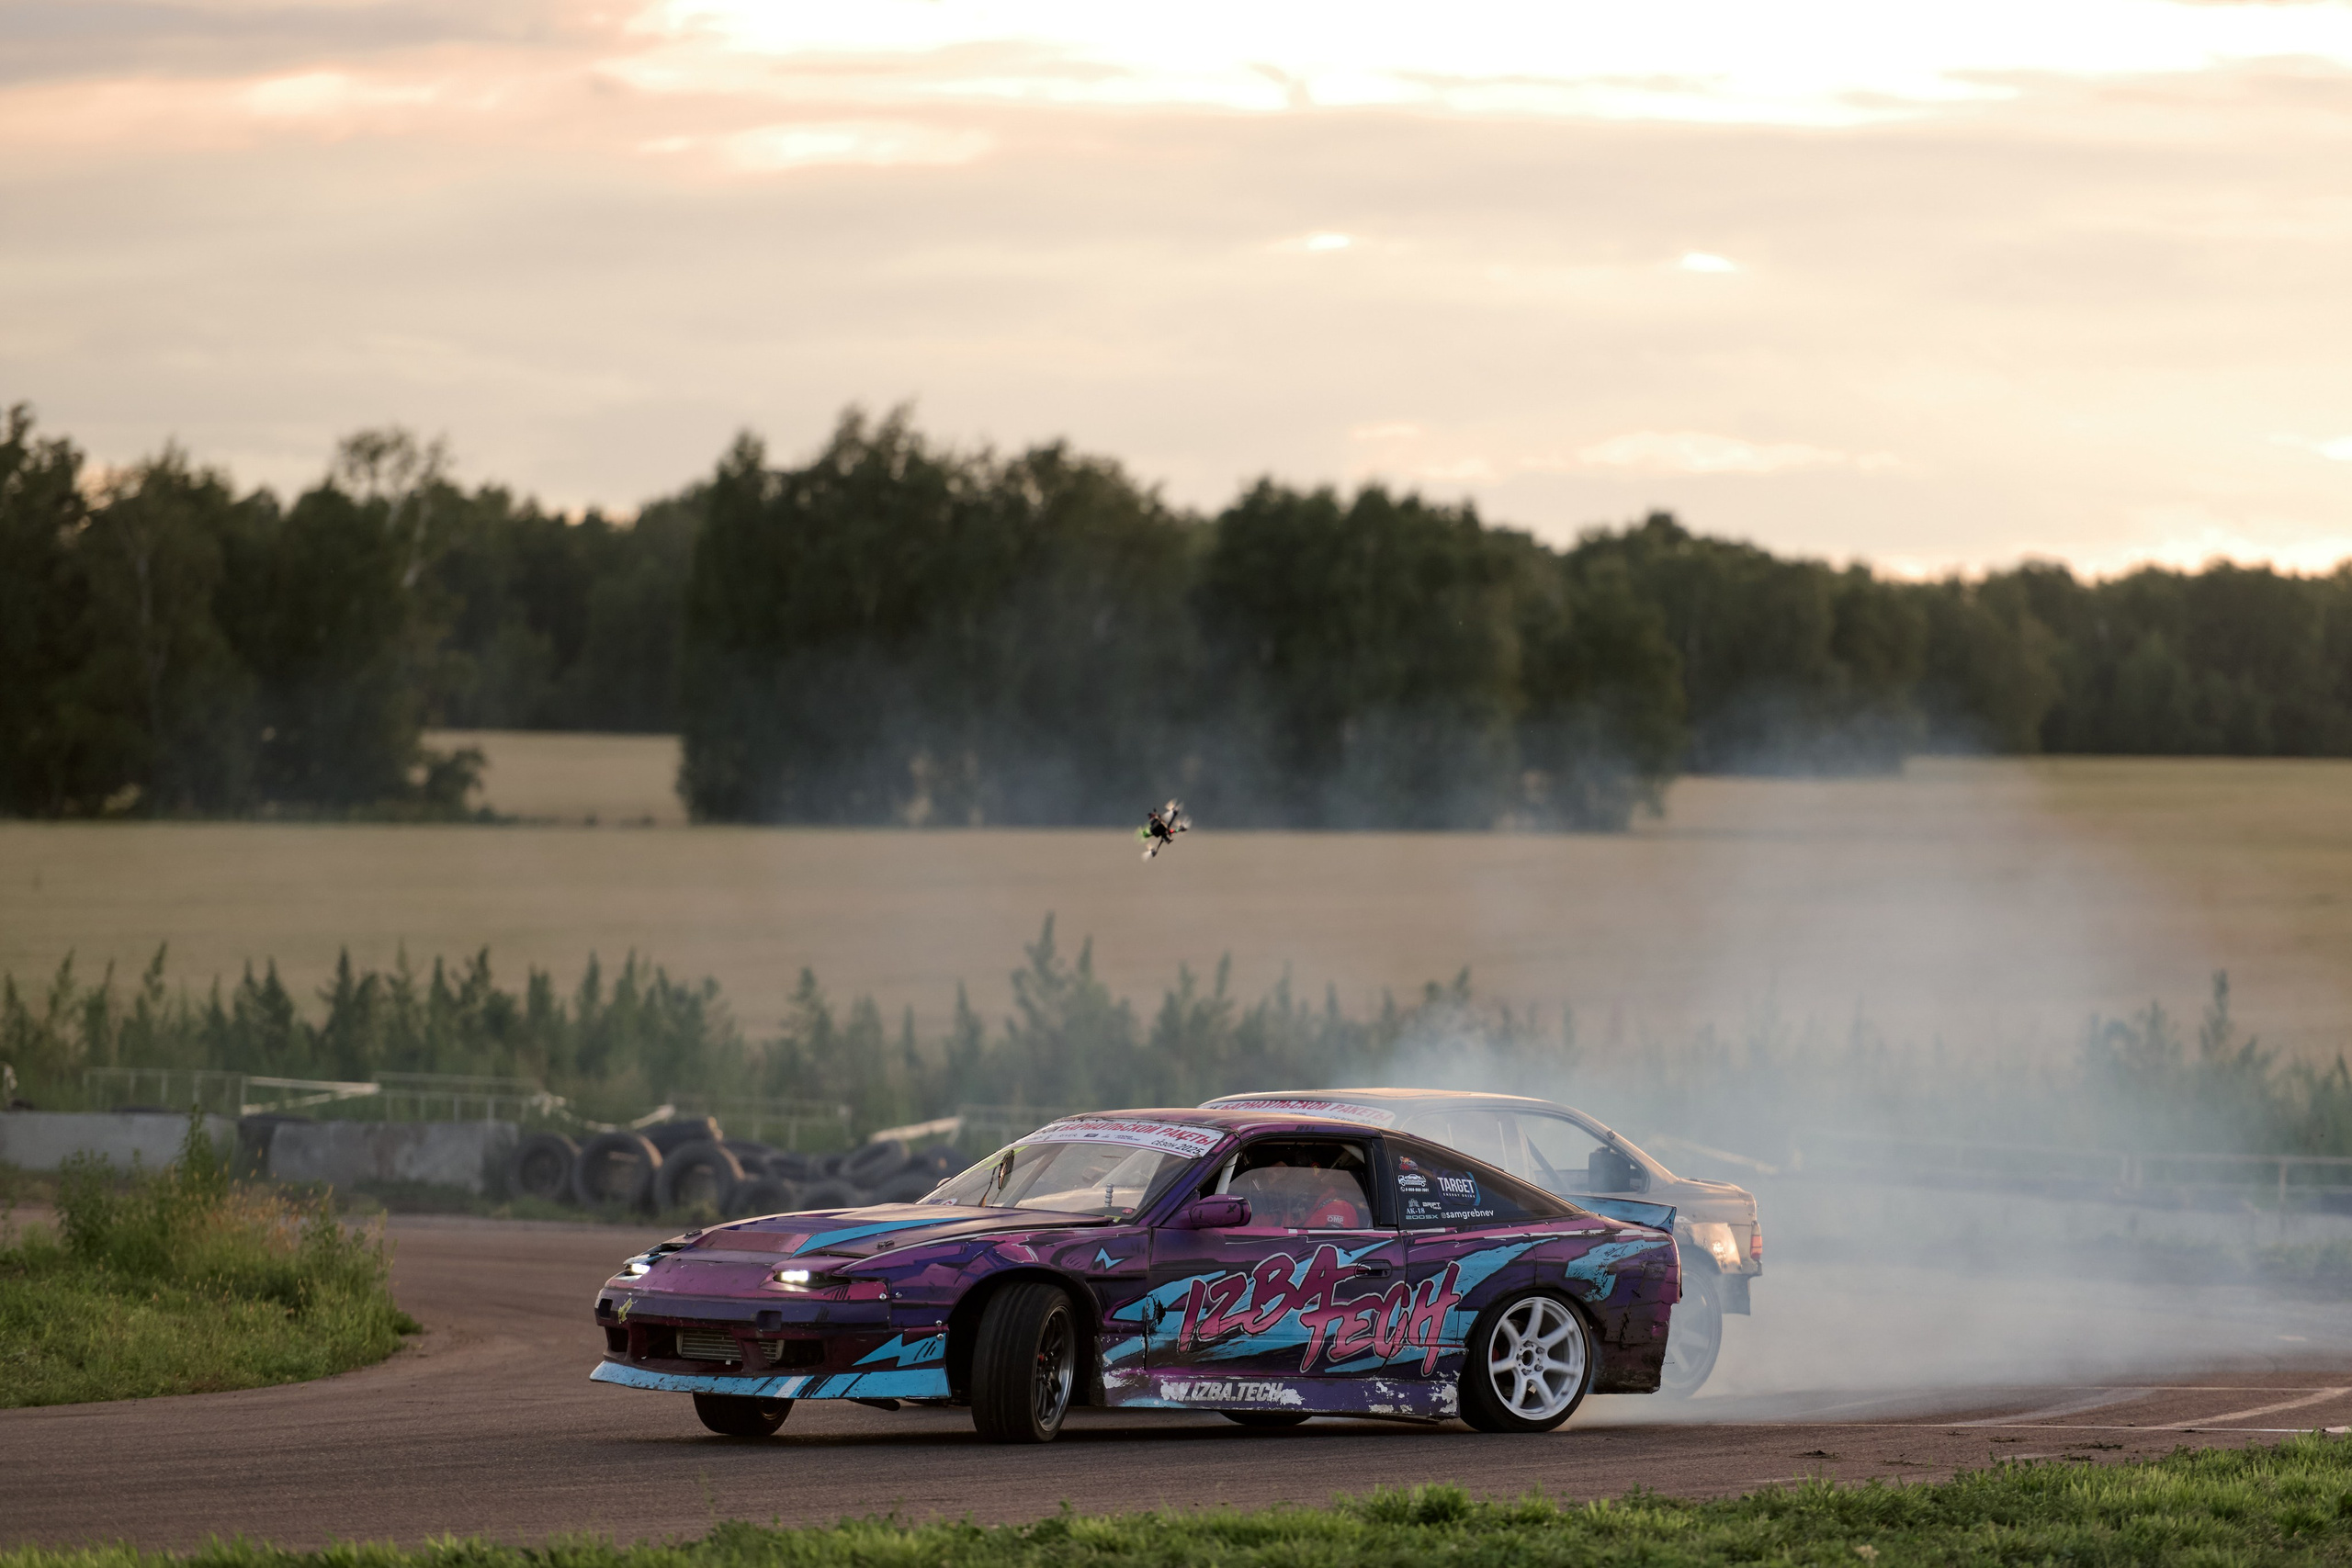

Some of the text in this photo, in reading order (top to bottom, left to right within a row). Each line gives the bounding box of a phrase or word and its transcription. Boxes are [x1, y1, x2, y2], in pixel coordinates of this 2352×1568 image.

[1329, 1103, 1394, 1122] РАКЕТЫ
[1158, 1127, 1219, 1145] РАКЕТЫ
[1176, 1143, 1204, 1155] 2025
[1437, 1177, 1475, 1193] TARGET
[1327, 1215, 1344, 1224] OMP
[1441, 1209, 1494, 1220] @samgrebnev
[1178, 1244, 1371, 1354] IZBA
[1299, 1260, 1463, 1377] TECH
